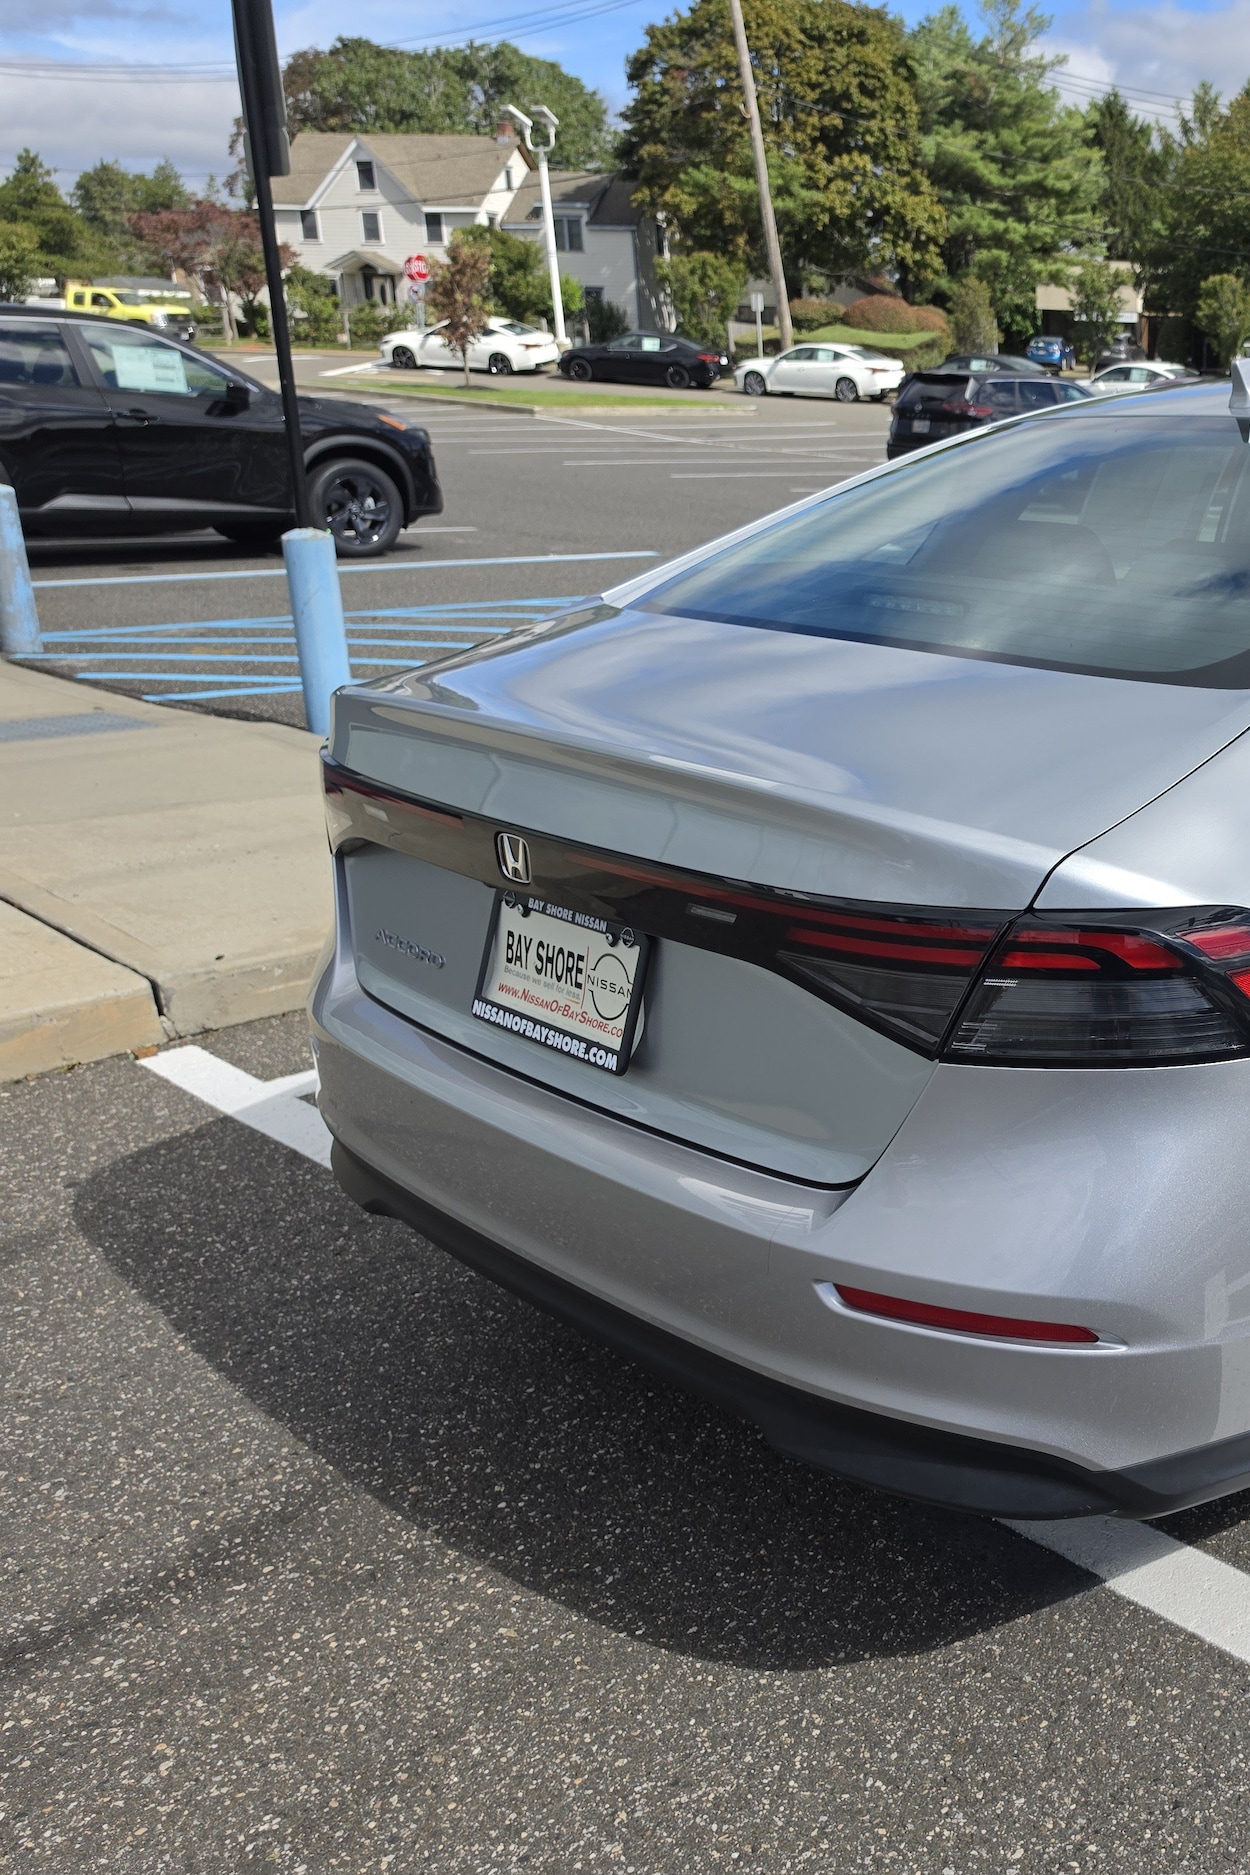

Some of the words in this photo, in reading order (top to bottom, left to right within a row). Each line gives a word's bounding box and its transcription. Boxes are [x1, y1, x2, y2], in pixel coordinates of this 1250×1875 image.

[528, 897, 545, 911] BAY
[546, 903, 573, 921] SHORE
[575, 911, 608, 933] NISSAN
[375, 928, 447, 968] ACCORD
[506, 929, 533, 970] BAY
[534, 940, 585, 990] SHORE
[503, 965, 531, 982] Because
[532, 976, 542, 986] we
[543, 978, 555, 990] sell
[555, 984, 566, 995] for
[587, 974, 633, 999] NISSAN
[472, 999, 618, 1071] NISSANOFBAYSHORE.COM
